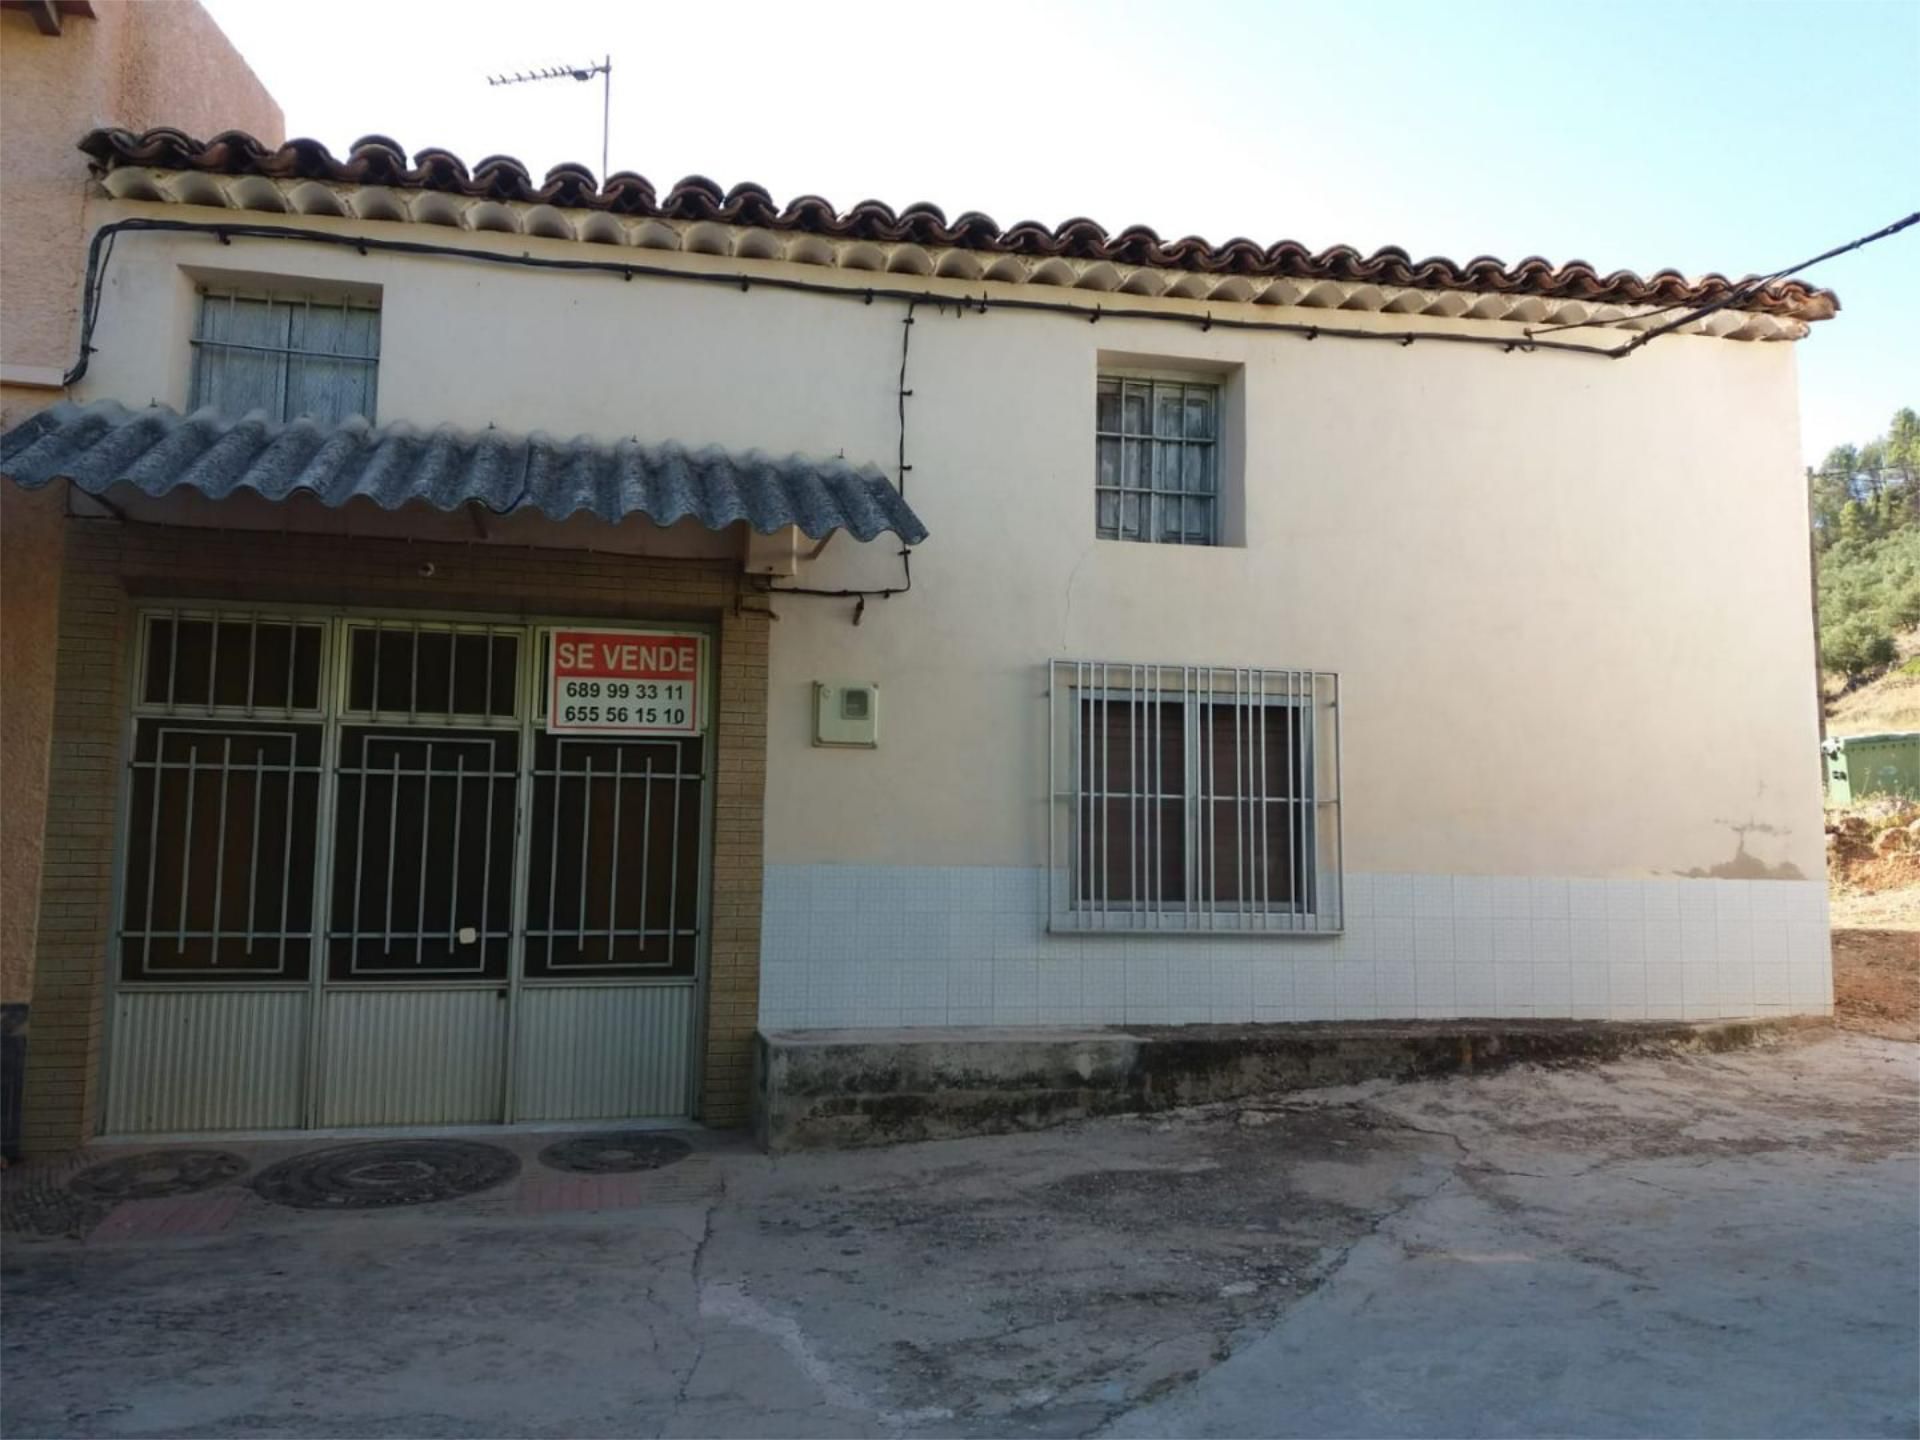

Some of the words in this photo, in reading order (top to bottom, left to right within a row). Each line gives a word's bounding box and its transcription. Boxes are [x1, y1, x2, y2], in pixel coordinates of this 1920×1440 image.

[558, 642, 595, 669] SE
[602, 644, 695, 672] VENDE
[566, 682, 600, 698] 689
[607, 683, 629, 699] 99
[636, 684, 658, 700] 33
[665, 685, 683, 701] 11
[565, 705, 600, 722] 655
[606, 707, 628, 722] 56
[635, 708, 657, 723] 15
[664, 709, 685, 724] 10
